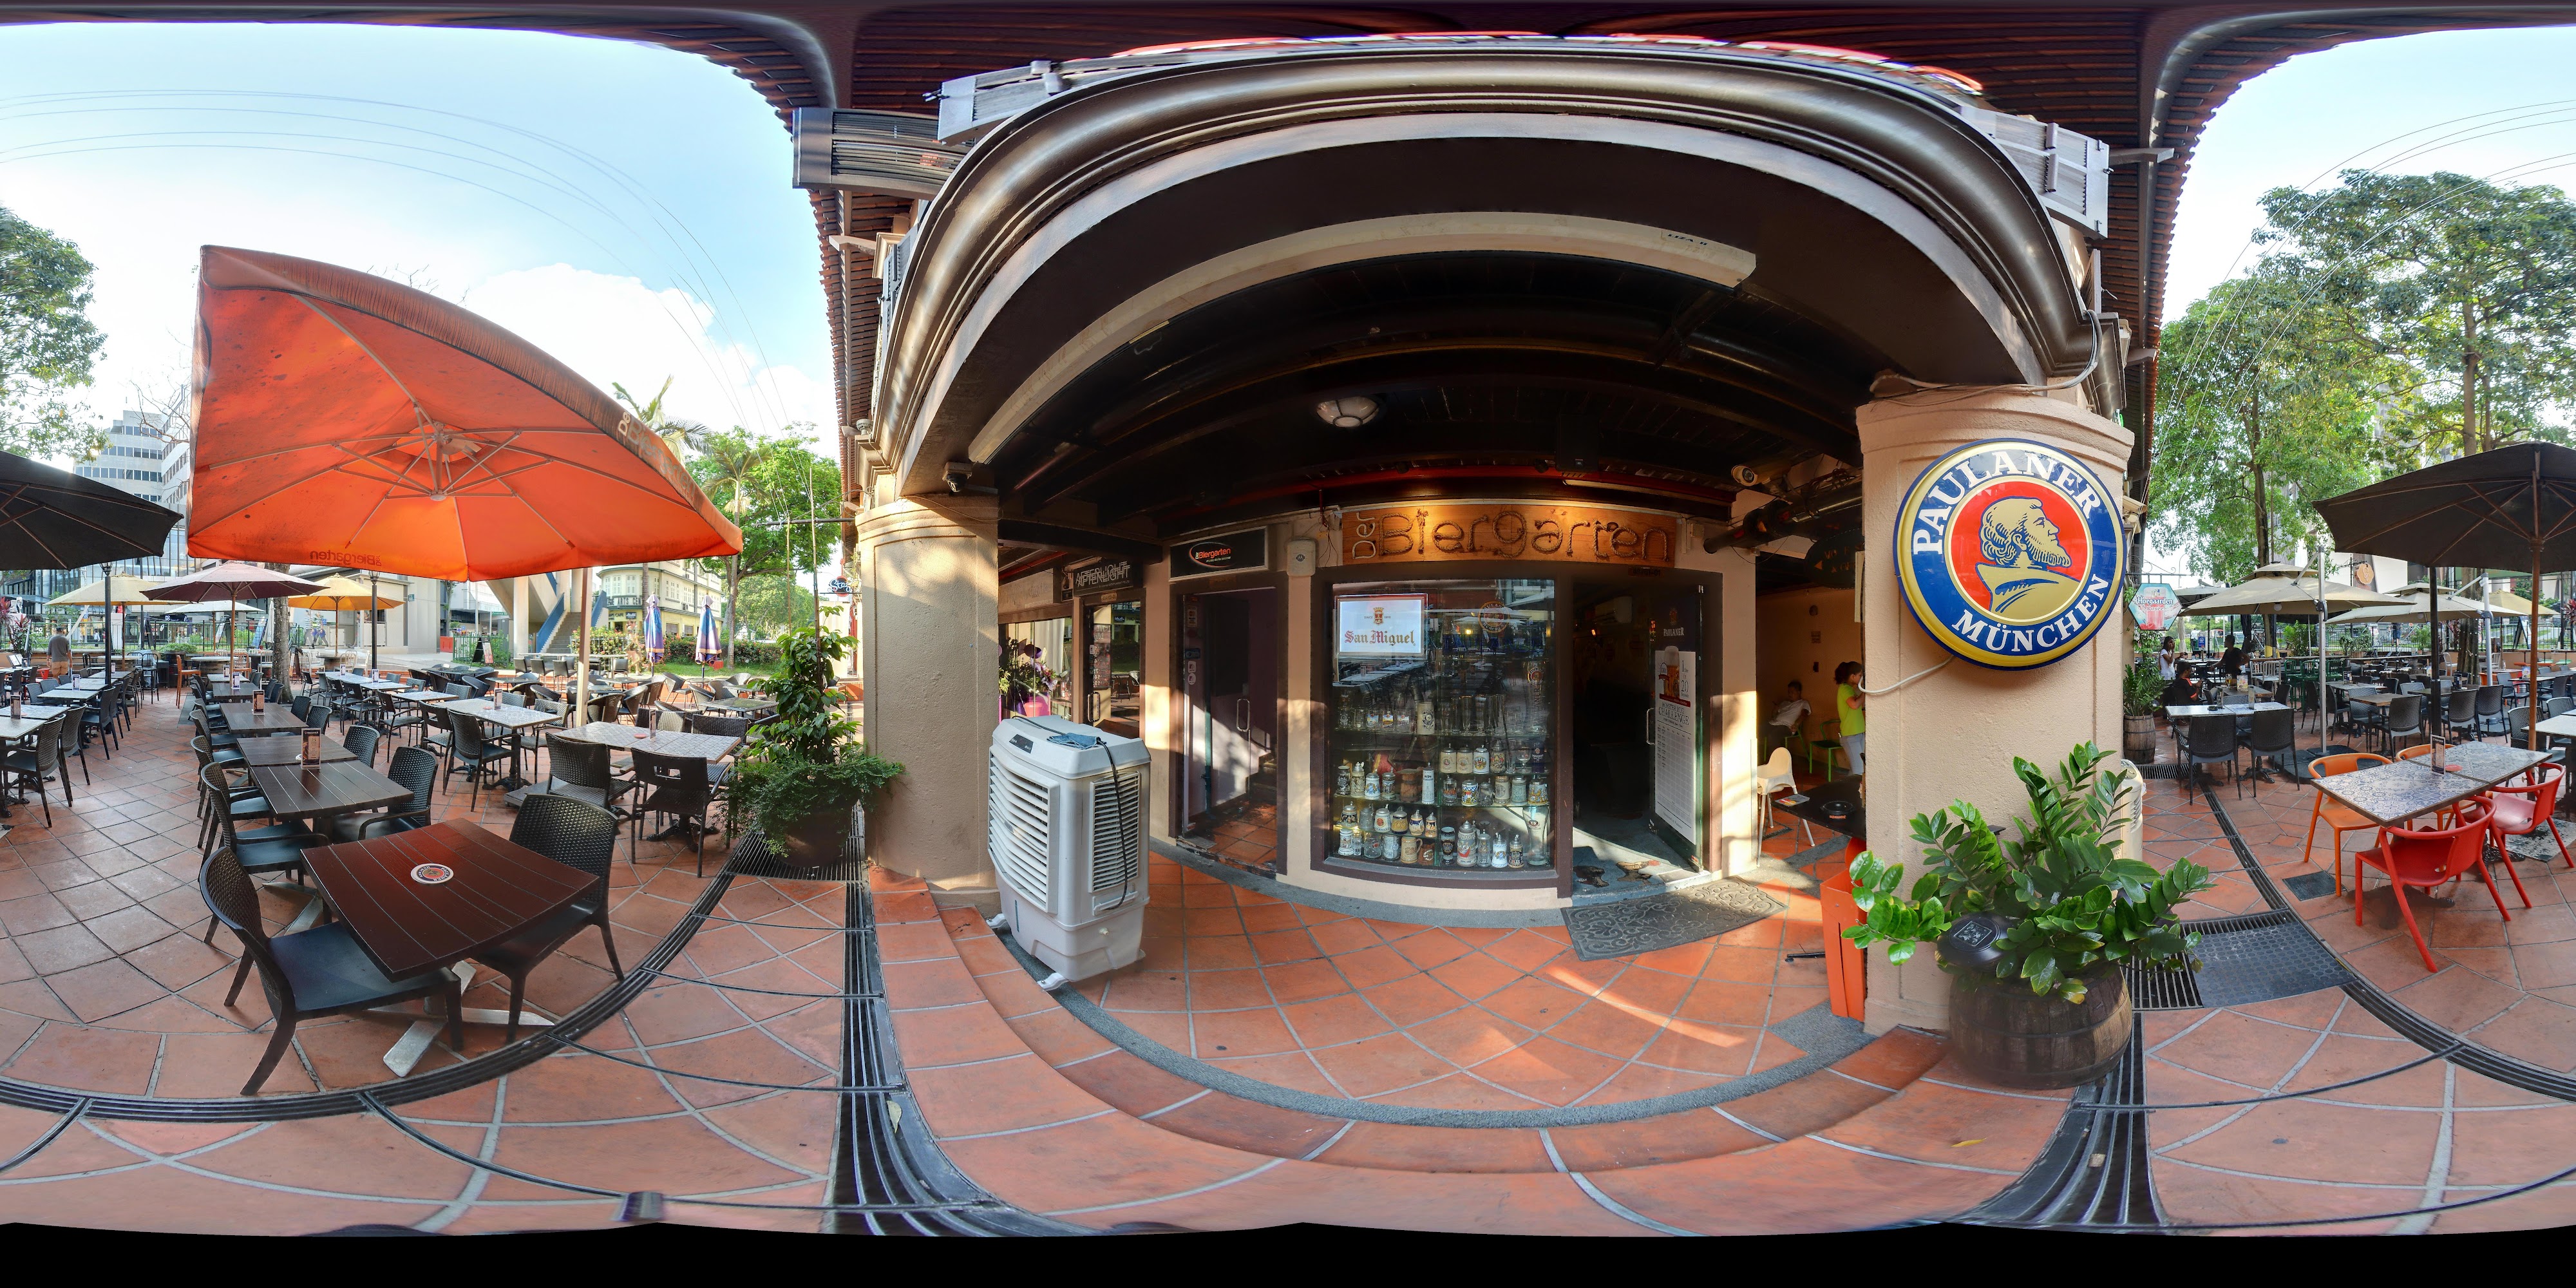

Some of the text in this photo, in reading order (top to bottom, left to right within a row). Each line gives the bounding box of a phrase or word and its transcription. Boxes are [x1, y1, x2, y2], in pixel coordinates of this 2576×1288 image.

[618, 411, 630, 437] De
[1913, 450, 2101, 555] PAULANER
[1352, 509, 1671, 561] Der Biergarten
[1198, 548, 1231, 559] Biergarten
[1075, 562, 1130, 587] AFTERLIGHT
[618, 597, 629, 605] ARTS
[2137, 596, 2174, 605] Hoegaarden
[1951, 573, 2110, 652] MÜNCHEN
[1345, 630, 1415, 646] San Miguel
[1663, 627, 1685, 636] PAULANER
[1681, 679, 1689, 693] 20
[1658, 707, 1689, 725] CHALLENGE
